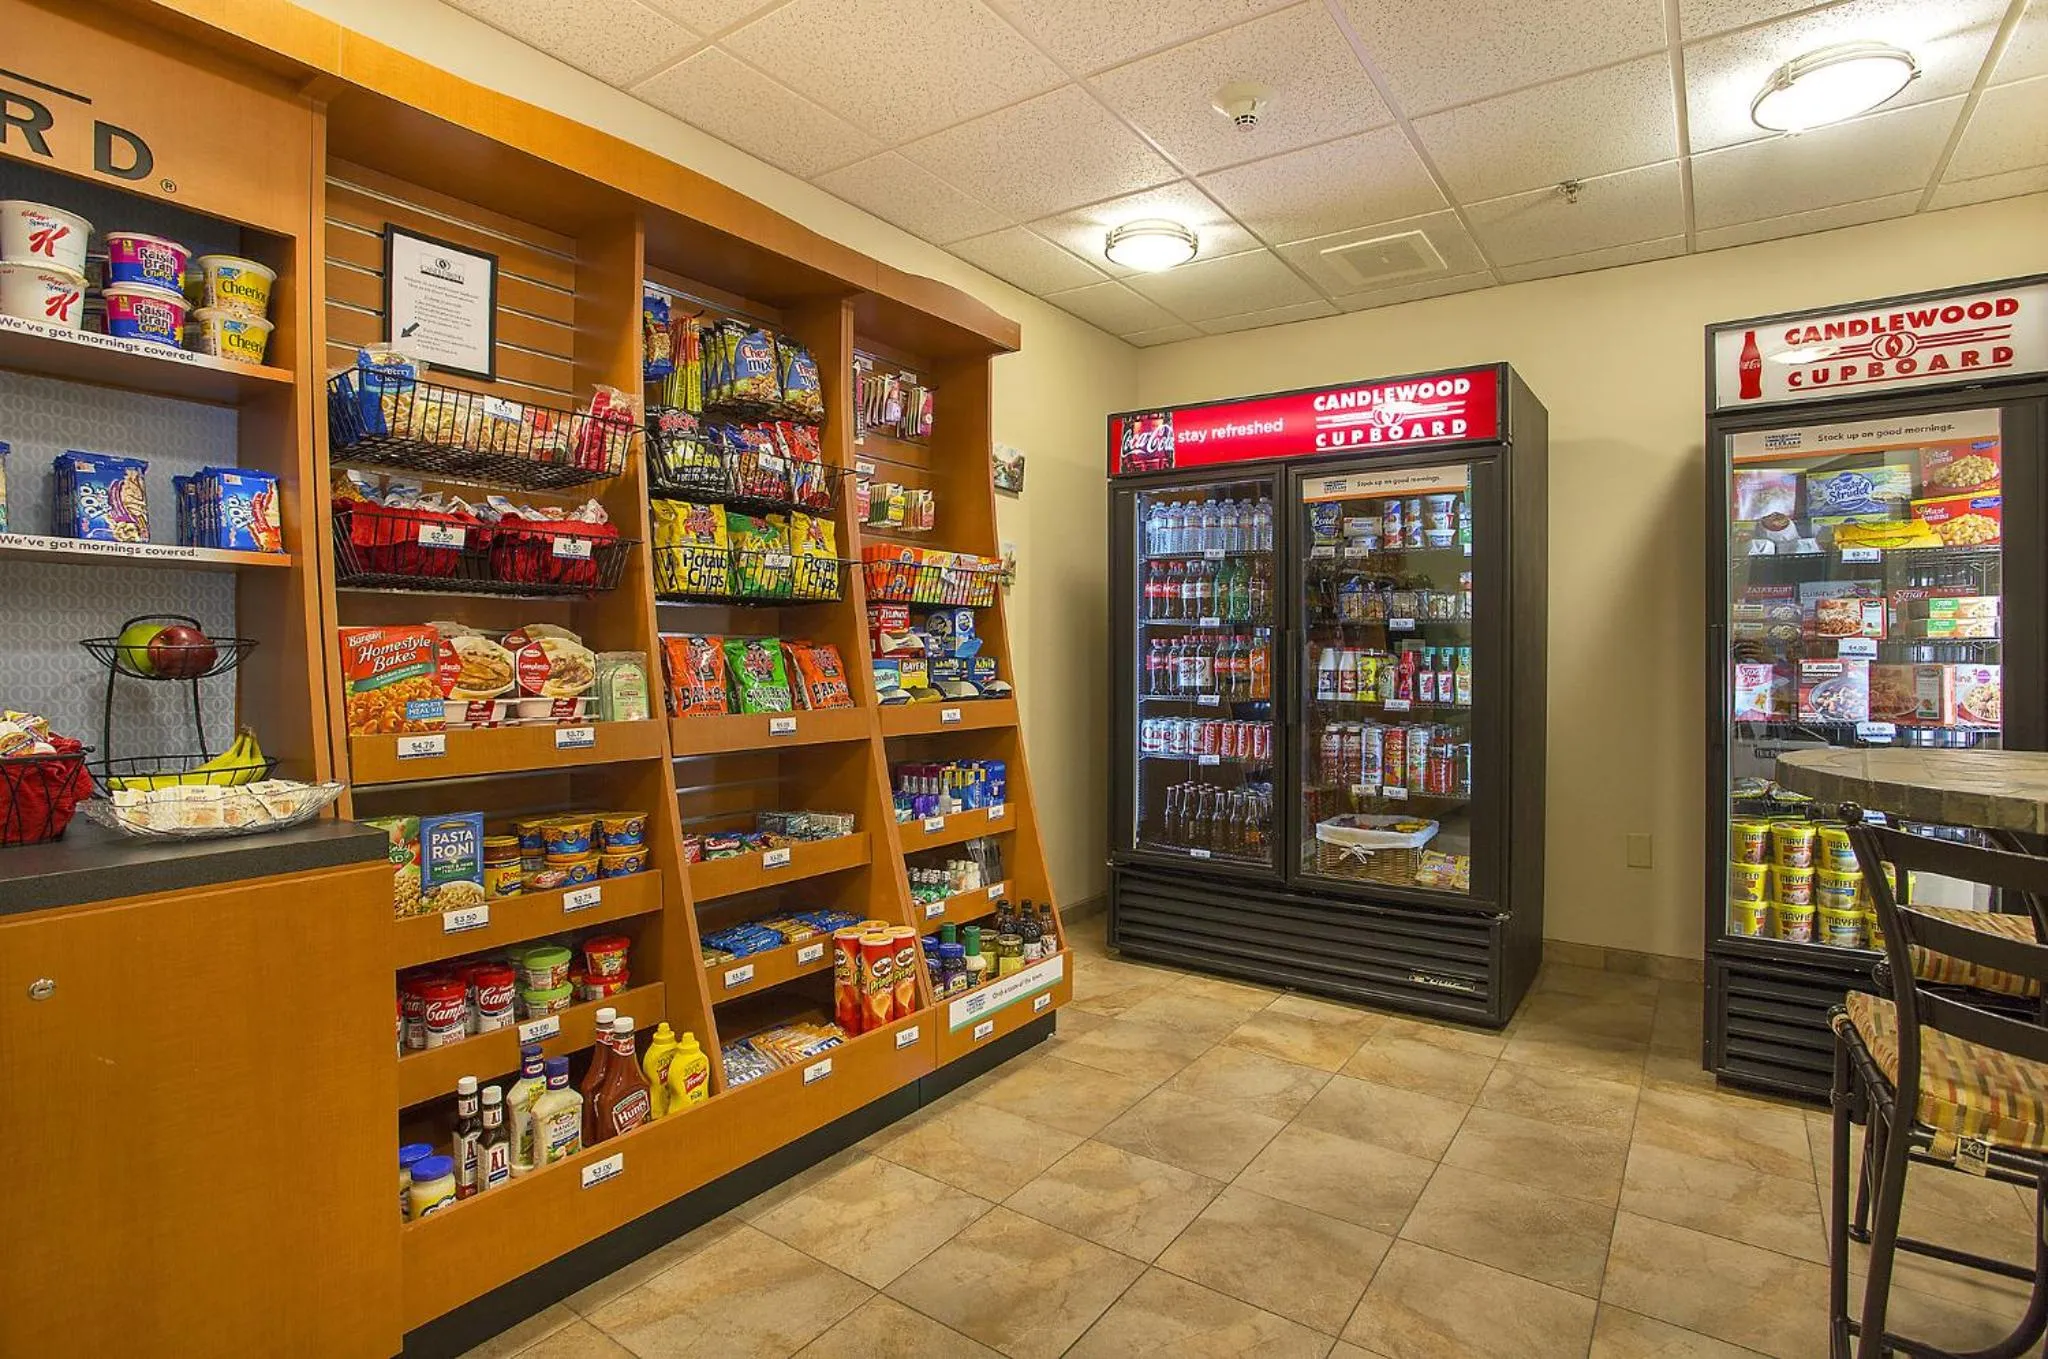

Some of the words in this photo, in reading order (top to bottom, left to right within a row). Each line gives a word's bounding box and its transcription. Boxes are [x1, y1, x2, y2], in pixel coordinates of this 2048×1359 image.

[29, 226, 70, 257] K
[139, 248, 177, 269] Raisin
[143, 260, 174, 276] Bran
[45, 291, 80, 321] K
[134, 303, 173, 321] Raisin
[139, 314, 169, 330] Bran
[1785, 298, 2019, 345] CANDLEWOOD
[1, 318, 43, 333] We've
[50, 327, 73, 338] got
[78, 333, 140, 352] mornings
[144, 345, 198, 362] covered.
[747, 358, 773, 373] mix
[1787, 346, 2014, 386] CUPBOARD
[1313, 378, 1471, 412] CANDLEWOOD
[1120, 424, 1175, 457] Coca-Cola
[1177, 429, 1207, 443] stay
[1211, 417, 1284, 440] refreshed
[1315, 419, 1467, 447] CUPBOARD
[1818, 433, 1844, 442] Stock
[1876, 428, 1902, 438] good
[1904, 423, 1955, 435] mornings.
[1828, 484, 1870, 501] Strudel
[1, 535, 44, 547] We've
[50, 539, 74, 550] got
[79, 542, 141, 556] mornings
[145, 548, 199, 558] covered.
[358, 635, 431, 664] Homestyle
[372, 650, 417, 674] Bakes
[408, 707, 430, 715] MEAL
[411, 741, 435, 750] $4.75
[432, 830, 475, 845] PASTA
[432, 841, 475, 860] RONI
[453, 913, 477, 924] $3.50
[618, 1100, 647, 1124] Hunt's
[491, 1148, 506, 1173] A1
